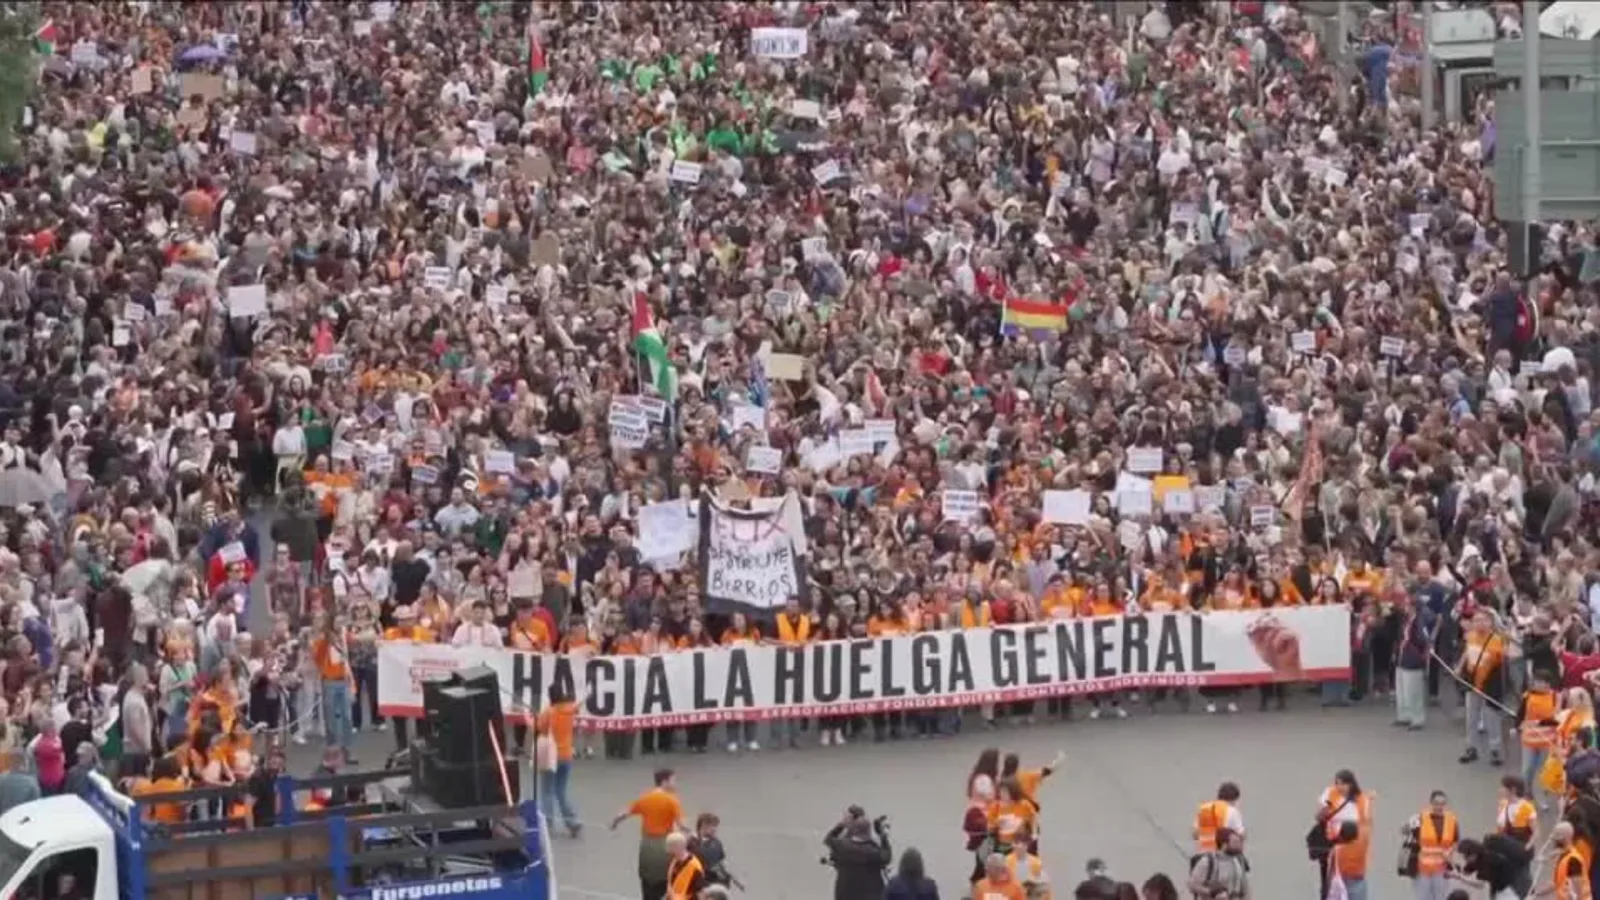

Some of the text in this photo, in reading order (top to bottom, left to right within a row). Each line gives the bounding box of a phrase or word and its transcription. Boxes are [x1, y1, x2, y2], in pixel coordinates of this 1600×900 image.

[513, 613, 1216, 718] HACIA LA HUELGA GENERAL
[594, 718, 627, 730] DEL
[631, 713, 709, 728] ALQUILER
[883, 698, 947, 710] FONDOS
[1016, 682, 1105, 698] CONTRATOS
[1109, 674, 1208, 689] INDEFINIDOS
